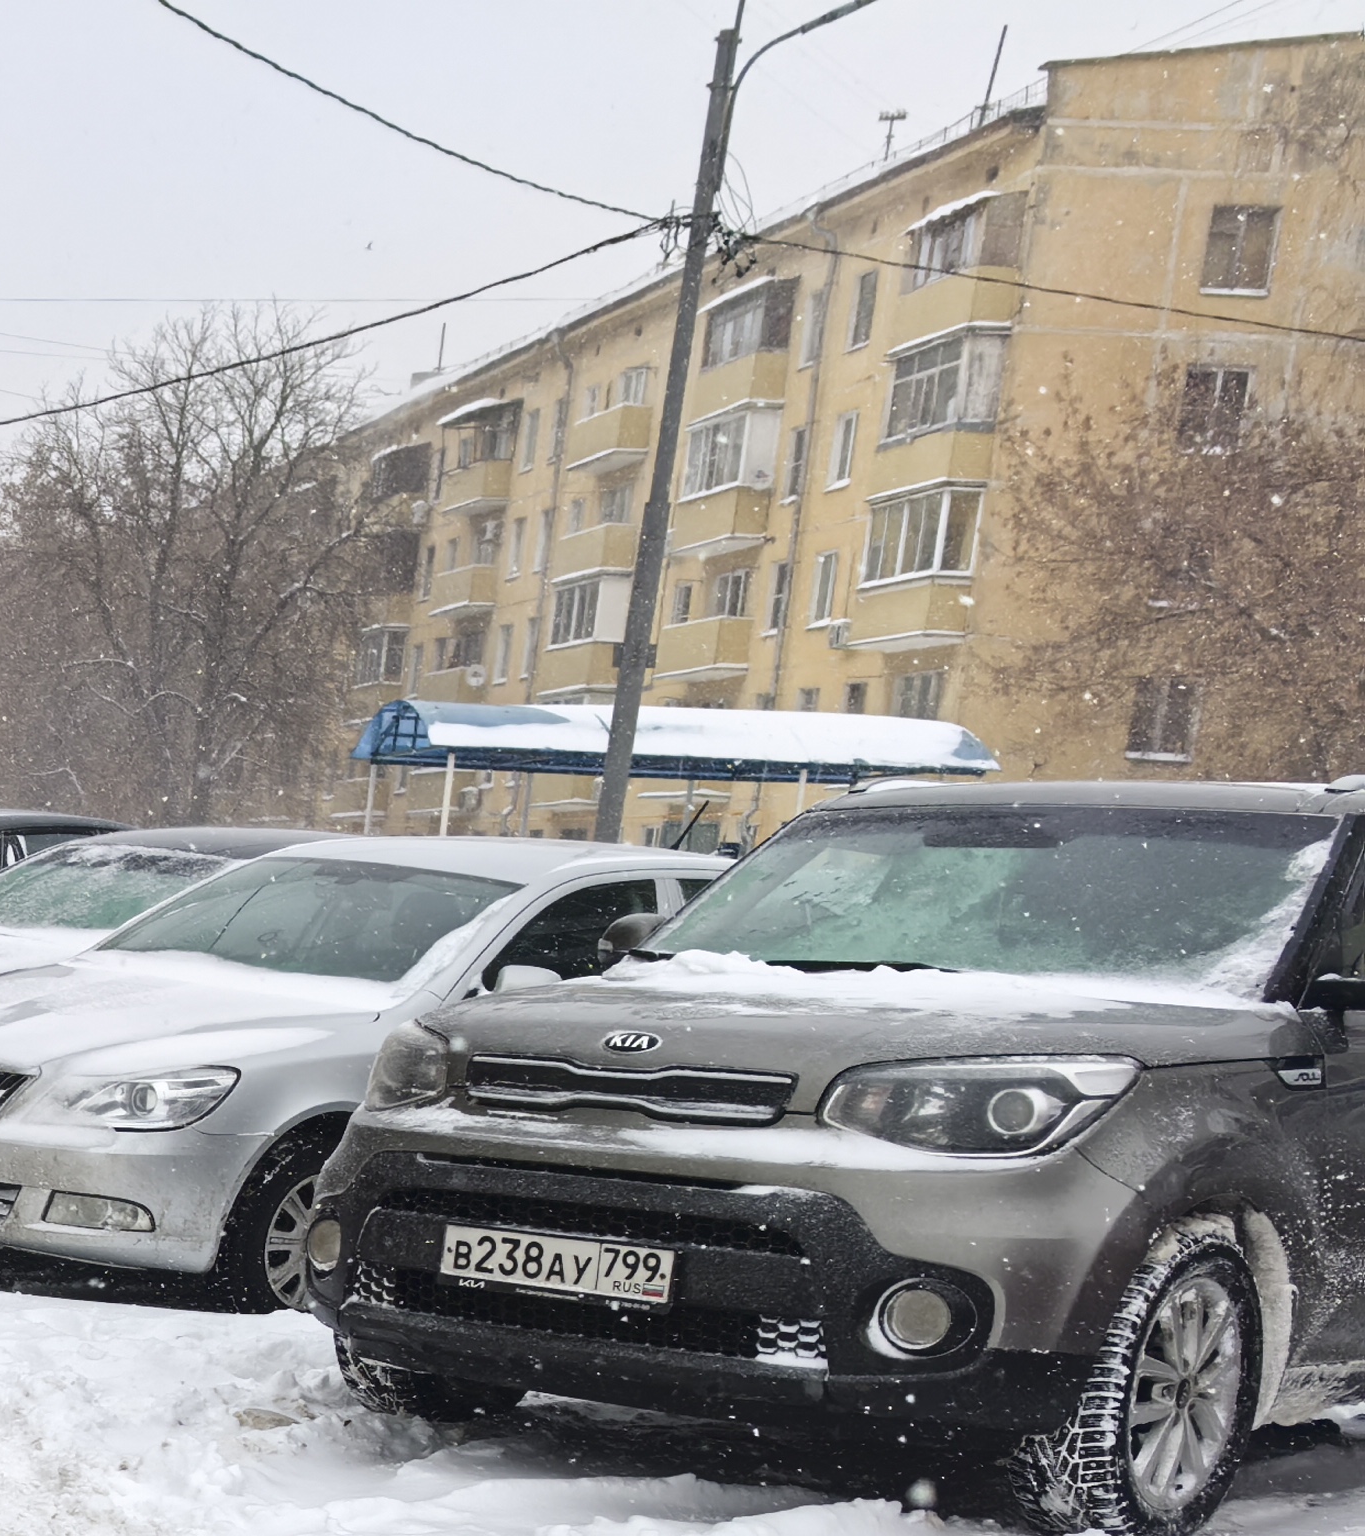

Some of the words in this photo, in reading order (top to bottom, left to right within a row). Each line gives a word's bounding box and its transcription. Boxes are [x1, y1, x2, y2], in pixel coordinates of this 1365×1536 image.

[608, 1034, 650, 1049] KIA
[603, 1247, 662, 1283] 799
[612, 1280, 642, 1295] RUS
